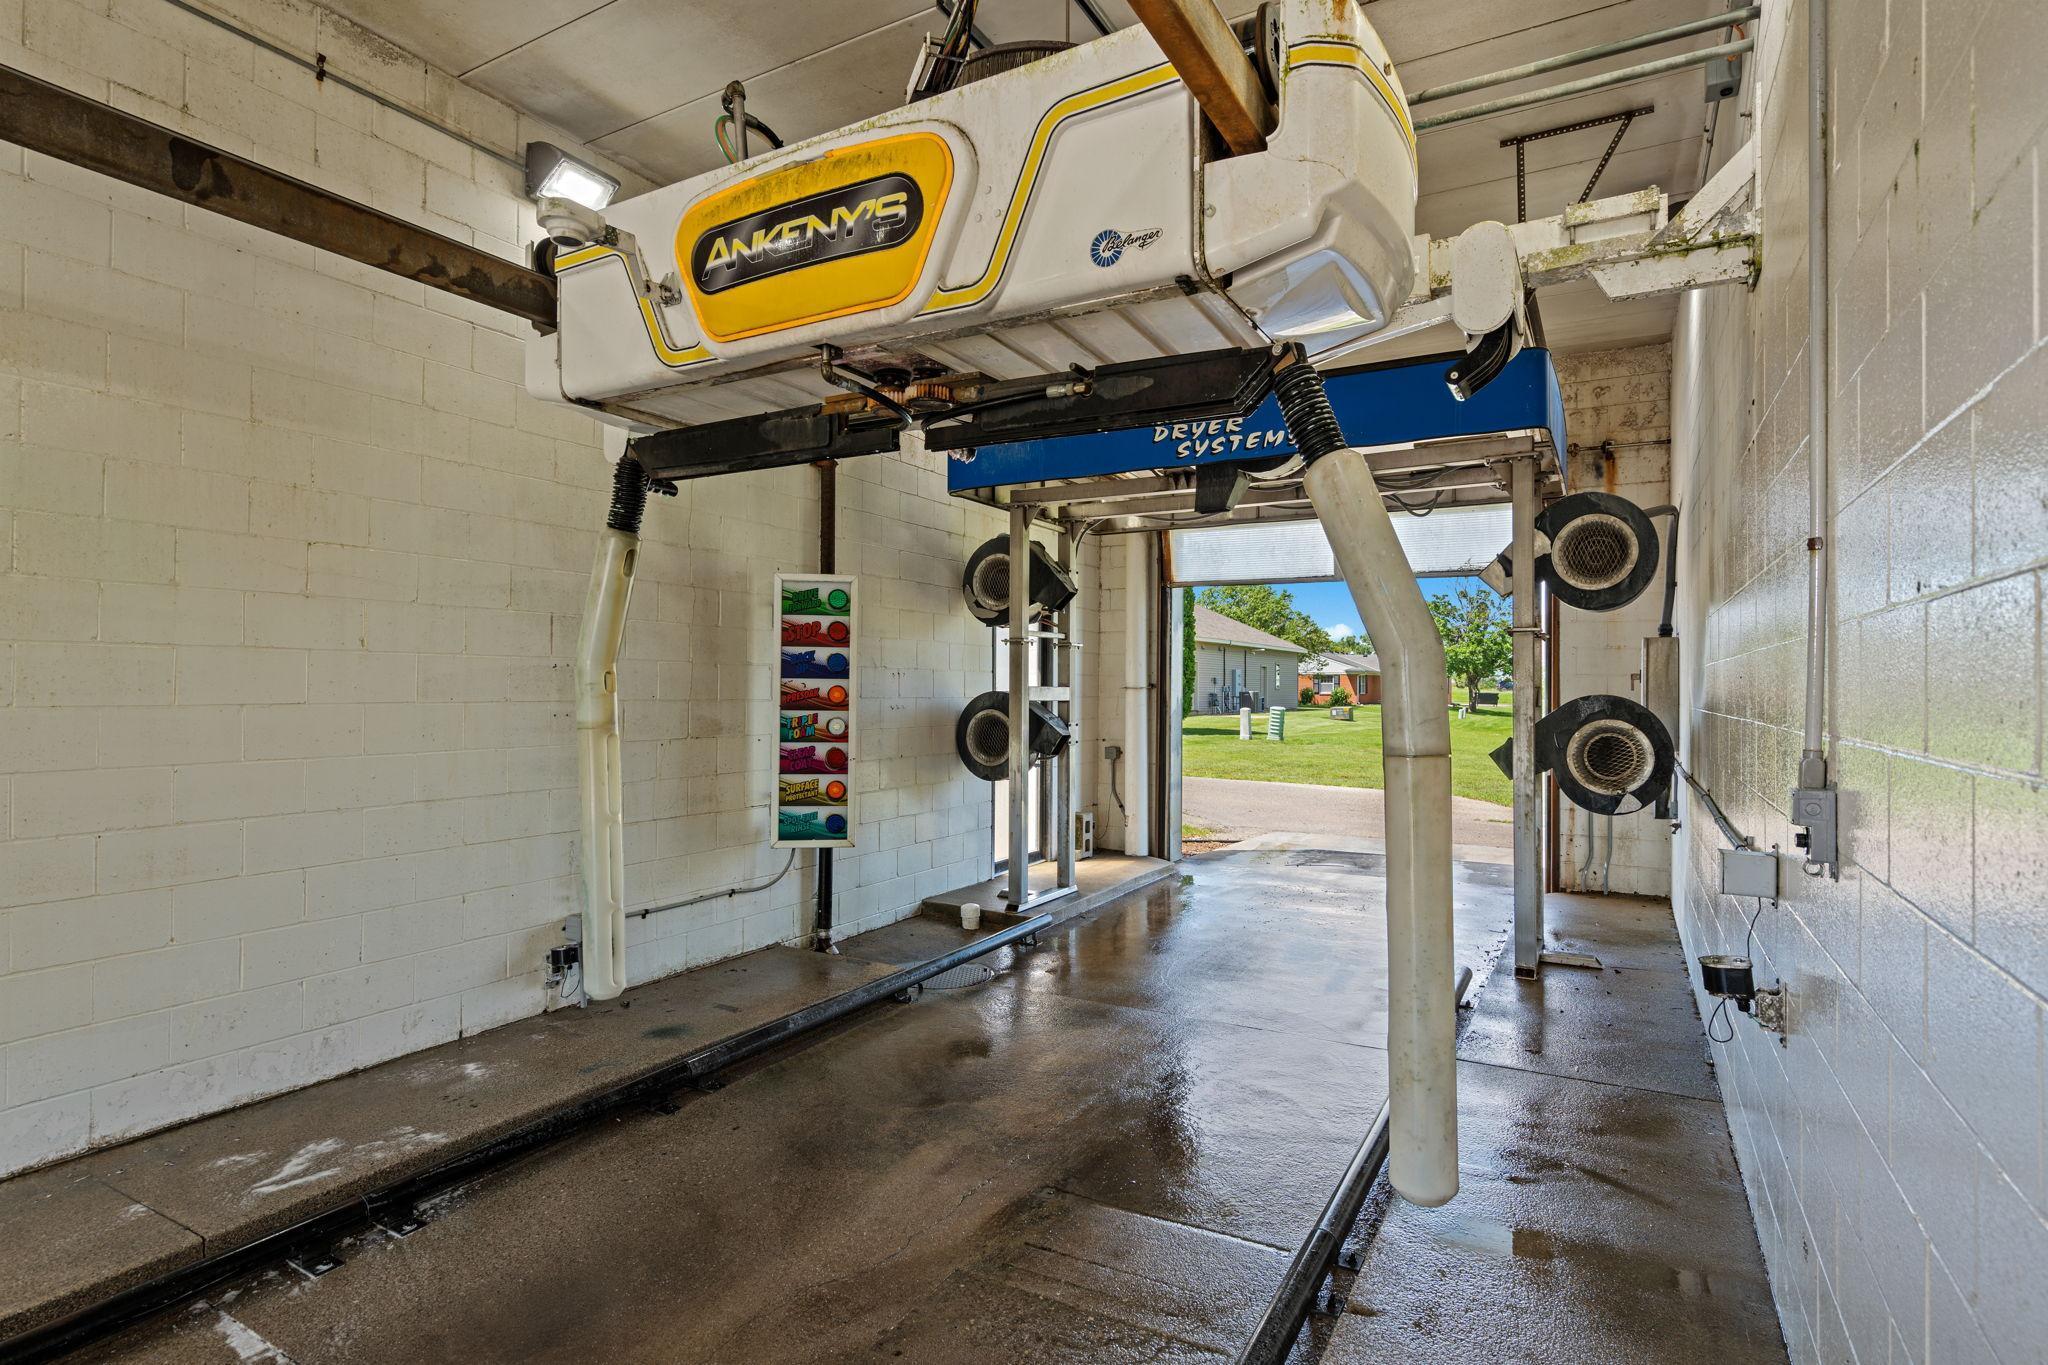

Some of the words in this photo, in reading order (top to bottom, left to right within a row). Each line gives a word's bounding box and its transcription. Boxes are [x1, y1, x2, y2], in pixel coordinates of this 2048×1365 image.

[701, 192, 908, 281] ANKENY'S
[1102, 230, 1161, 254] Belanger
[1154, 418, 1244, 442] DRYER
[782, 621, 821, 641] STOP
[787, 713, 818, 729] TRIPLE
[788, 726, 815, 739] FOAM
[786, 779, 819, 794] SURFACE
[785, 790, 818, 802] PROTECTANT
